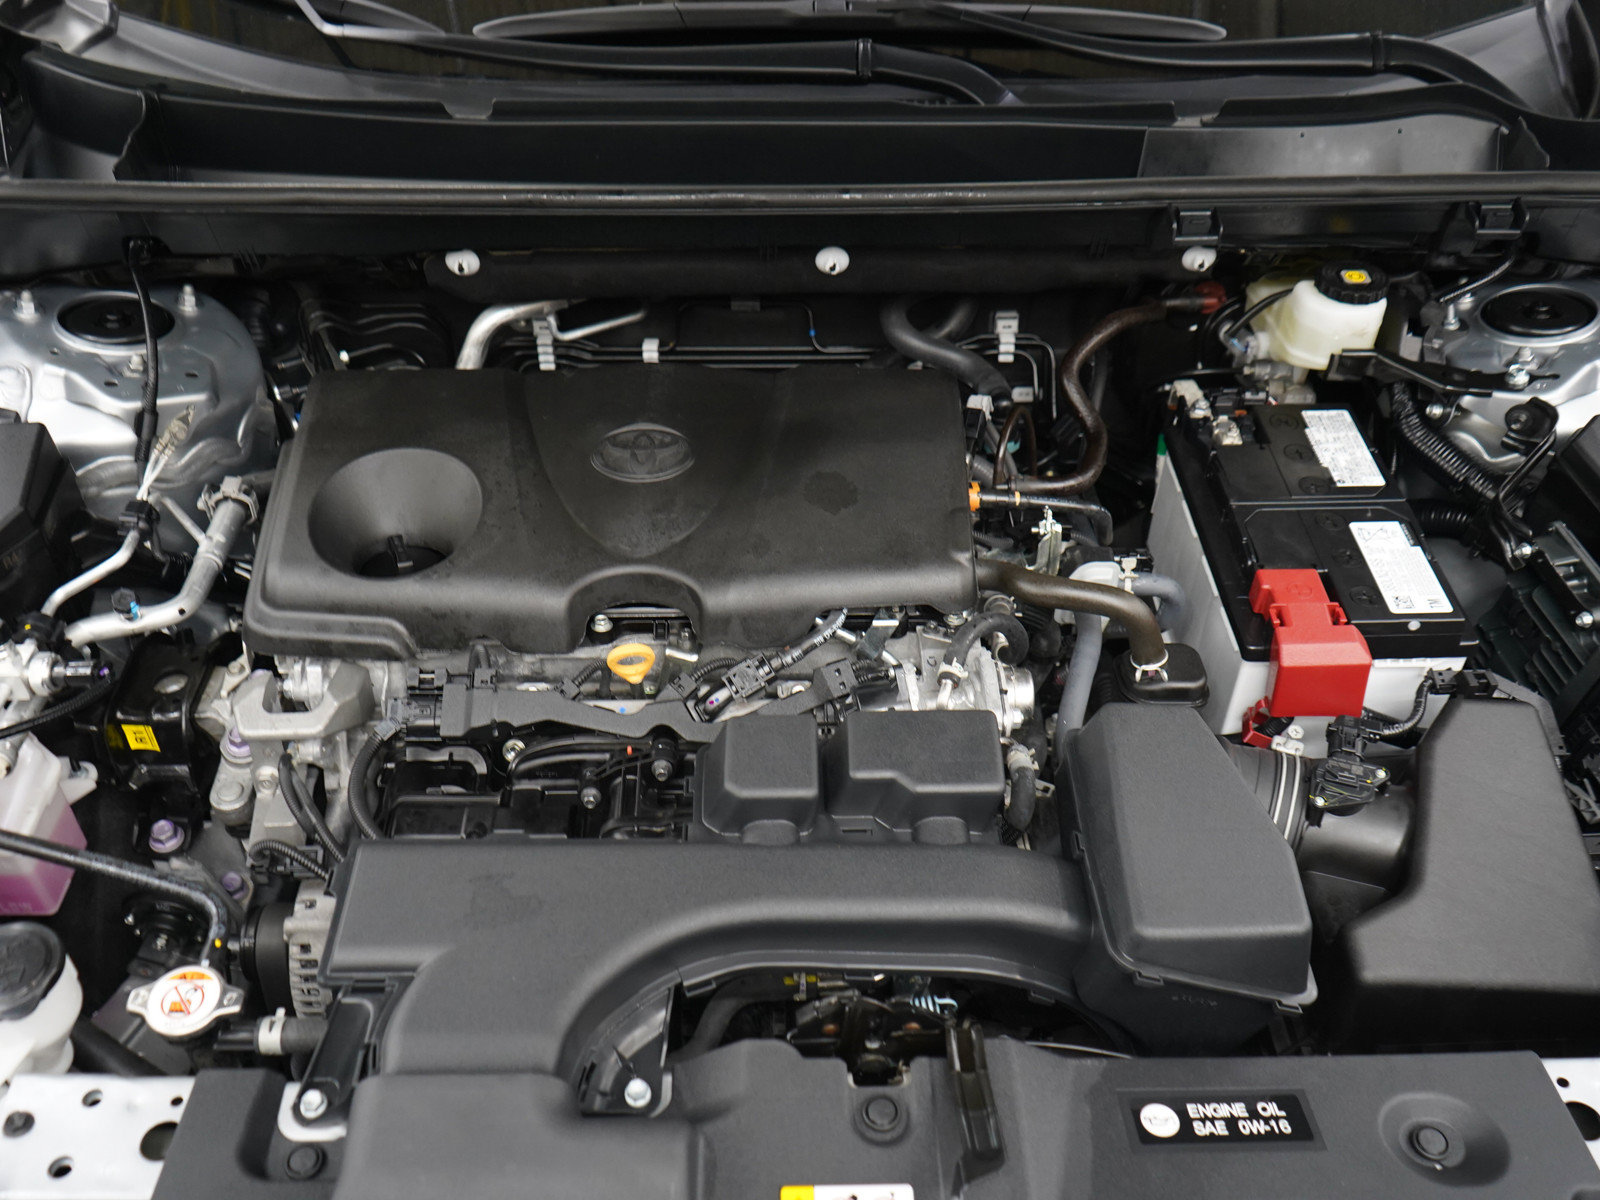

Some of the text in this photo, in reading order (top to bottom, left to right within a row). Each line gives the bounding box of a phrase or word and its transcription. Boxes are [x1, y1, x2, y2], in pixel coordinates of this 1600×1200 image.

[1186, 1101, 1286, 1118] ENGINE OIL
[1192, 1118, 1292, 1136] SAE 0W-16
